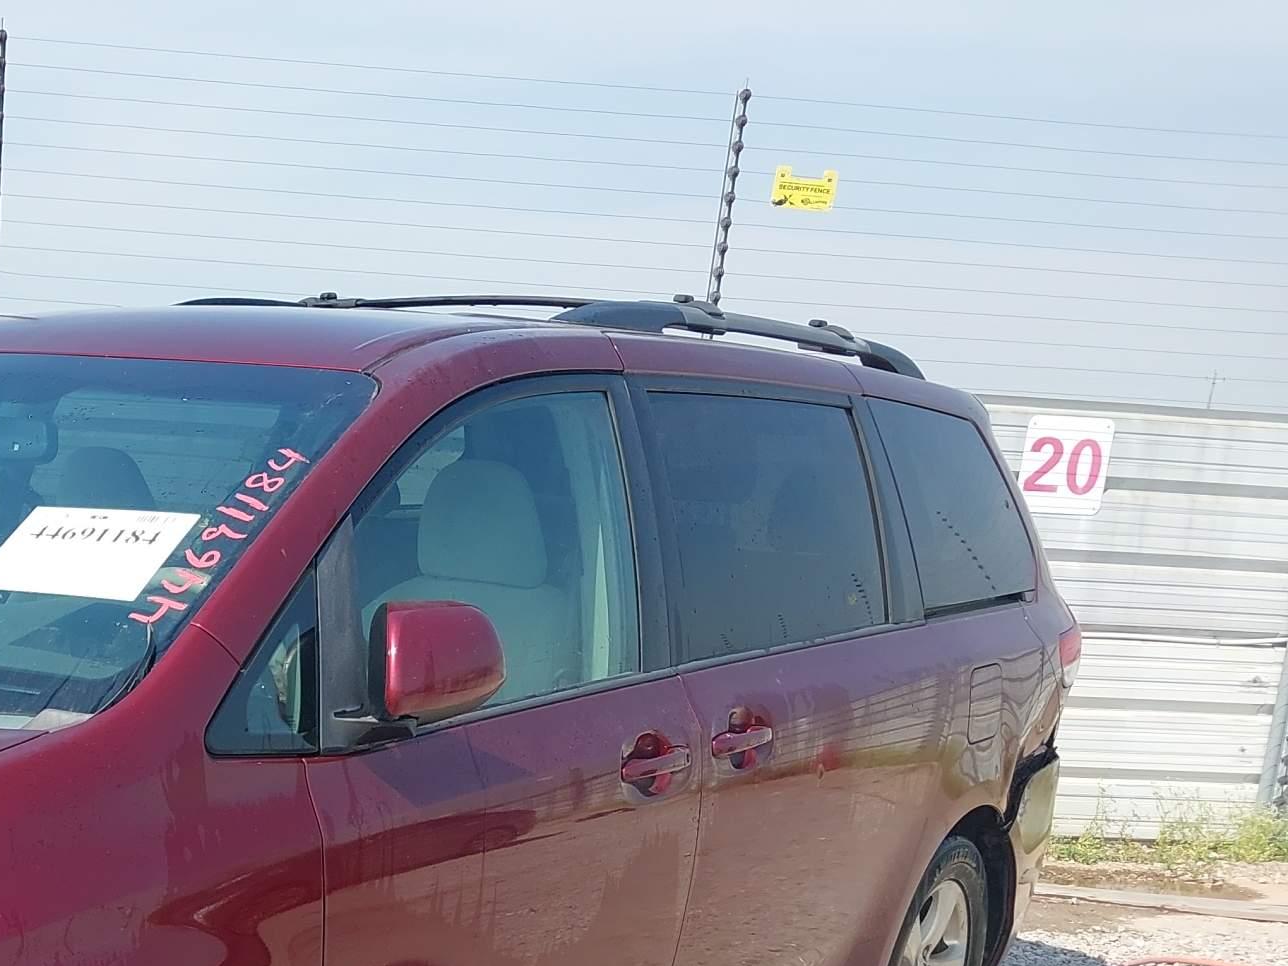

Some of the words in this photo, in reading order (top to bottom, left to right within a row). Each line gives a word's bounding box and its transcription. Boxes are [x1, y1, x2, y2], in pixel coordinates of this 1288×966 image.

[778, 184, 810, 193] SECURITY
[809, 187, 831, 195] FENCE
[1023, 436, 1102, 496] 20
[30, 525, 162, 545] 44691184
[128, 448, 310, 624] 44691184
